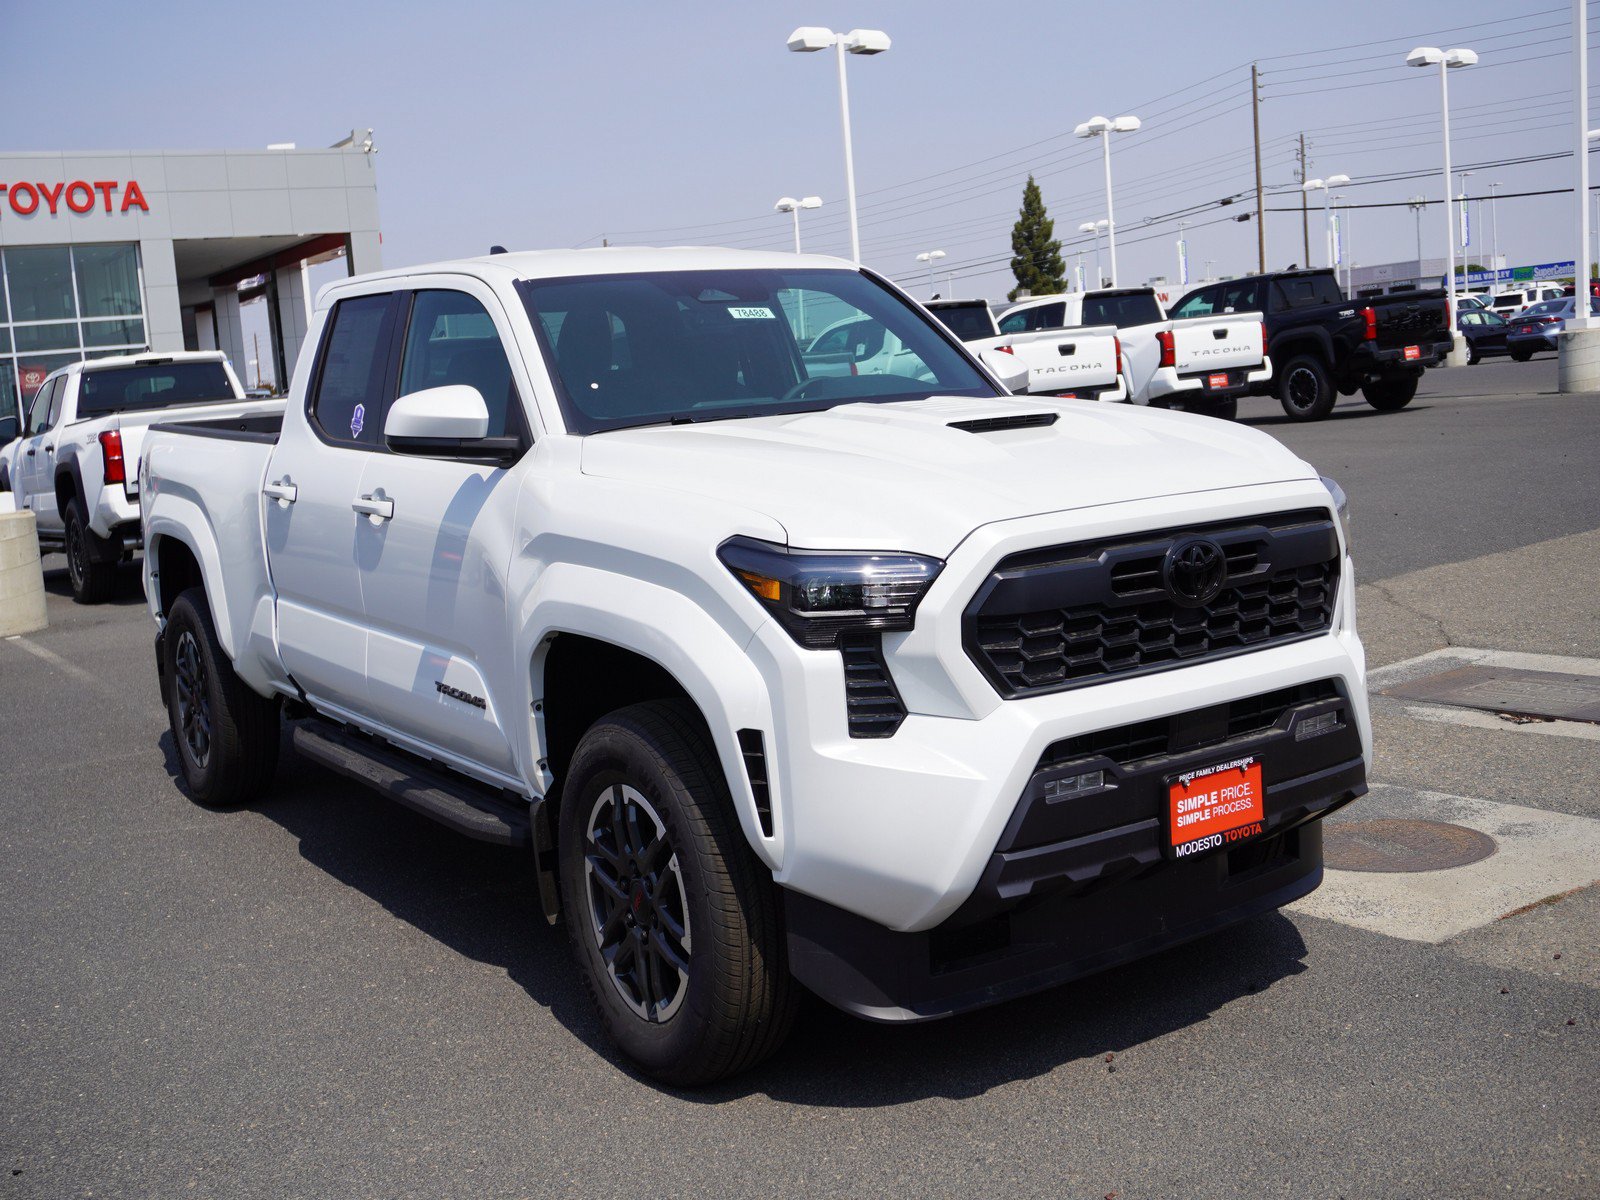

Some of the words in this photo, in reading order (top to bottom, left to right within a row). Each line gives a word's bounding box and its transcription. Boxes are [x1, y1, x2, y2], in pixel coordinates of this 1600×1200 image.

[1534, 263, 1575, 279] SuperCente
[735, 309, 768, 317] 78488
[1191, 345, 1251, 357] TACOMA
[1034, 362, 1102, 374] TACOMA
[434, 681, 487, 710] TACOMA
[1179, 771, 1195, 782] PRICE
[1196, 766, 1215, 777] FAMILY
[1216, 756, 1254, 771] DEALERSHIPS
[1177, 791, 1218, 814] SIMPLE
[1221, 782, 1253, 801] PRICE.
[1177, 808, 1211, 827] SIMPLE
[1212, 798, 1254, 817] PROCESS.
[1176, 834, 1222, 857] MODESTO
[1224, 822, 1263, 843] TOYOTA
